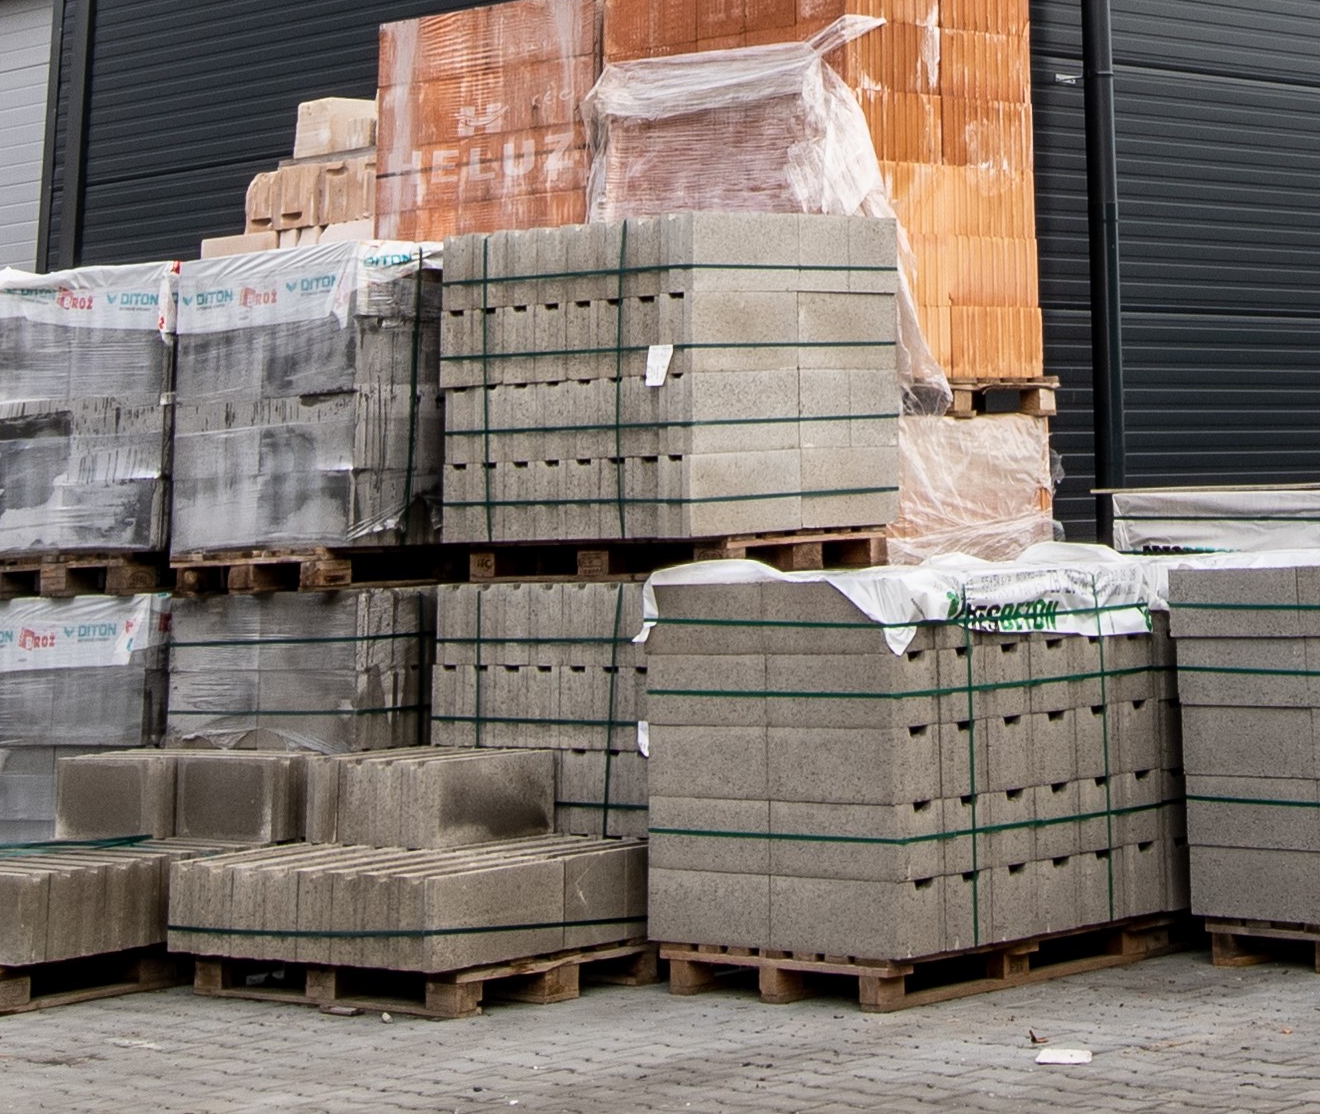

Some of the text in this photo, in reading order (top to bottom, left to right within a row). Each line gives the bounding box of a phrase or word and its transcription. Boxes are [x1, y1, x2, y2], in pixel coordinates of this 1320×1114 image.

[388, 132, 576, 187] HELUZ
[120, 293, 159, 306] DITON
[196, 289, 233, 306] DITON
[78, 623, 117, 637] DITON
